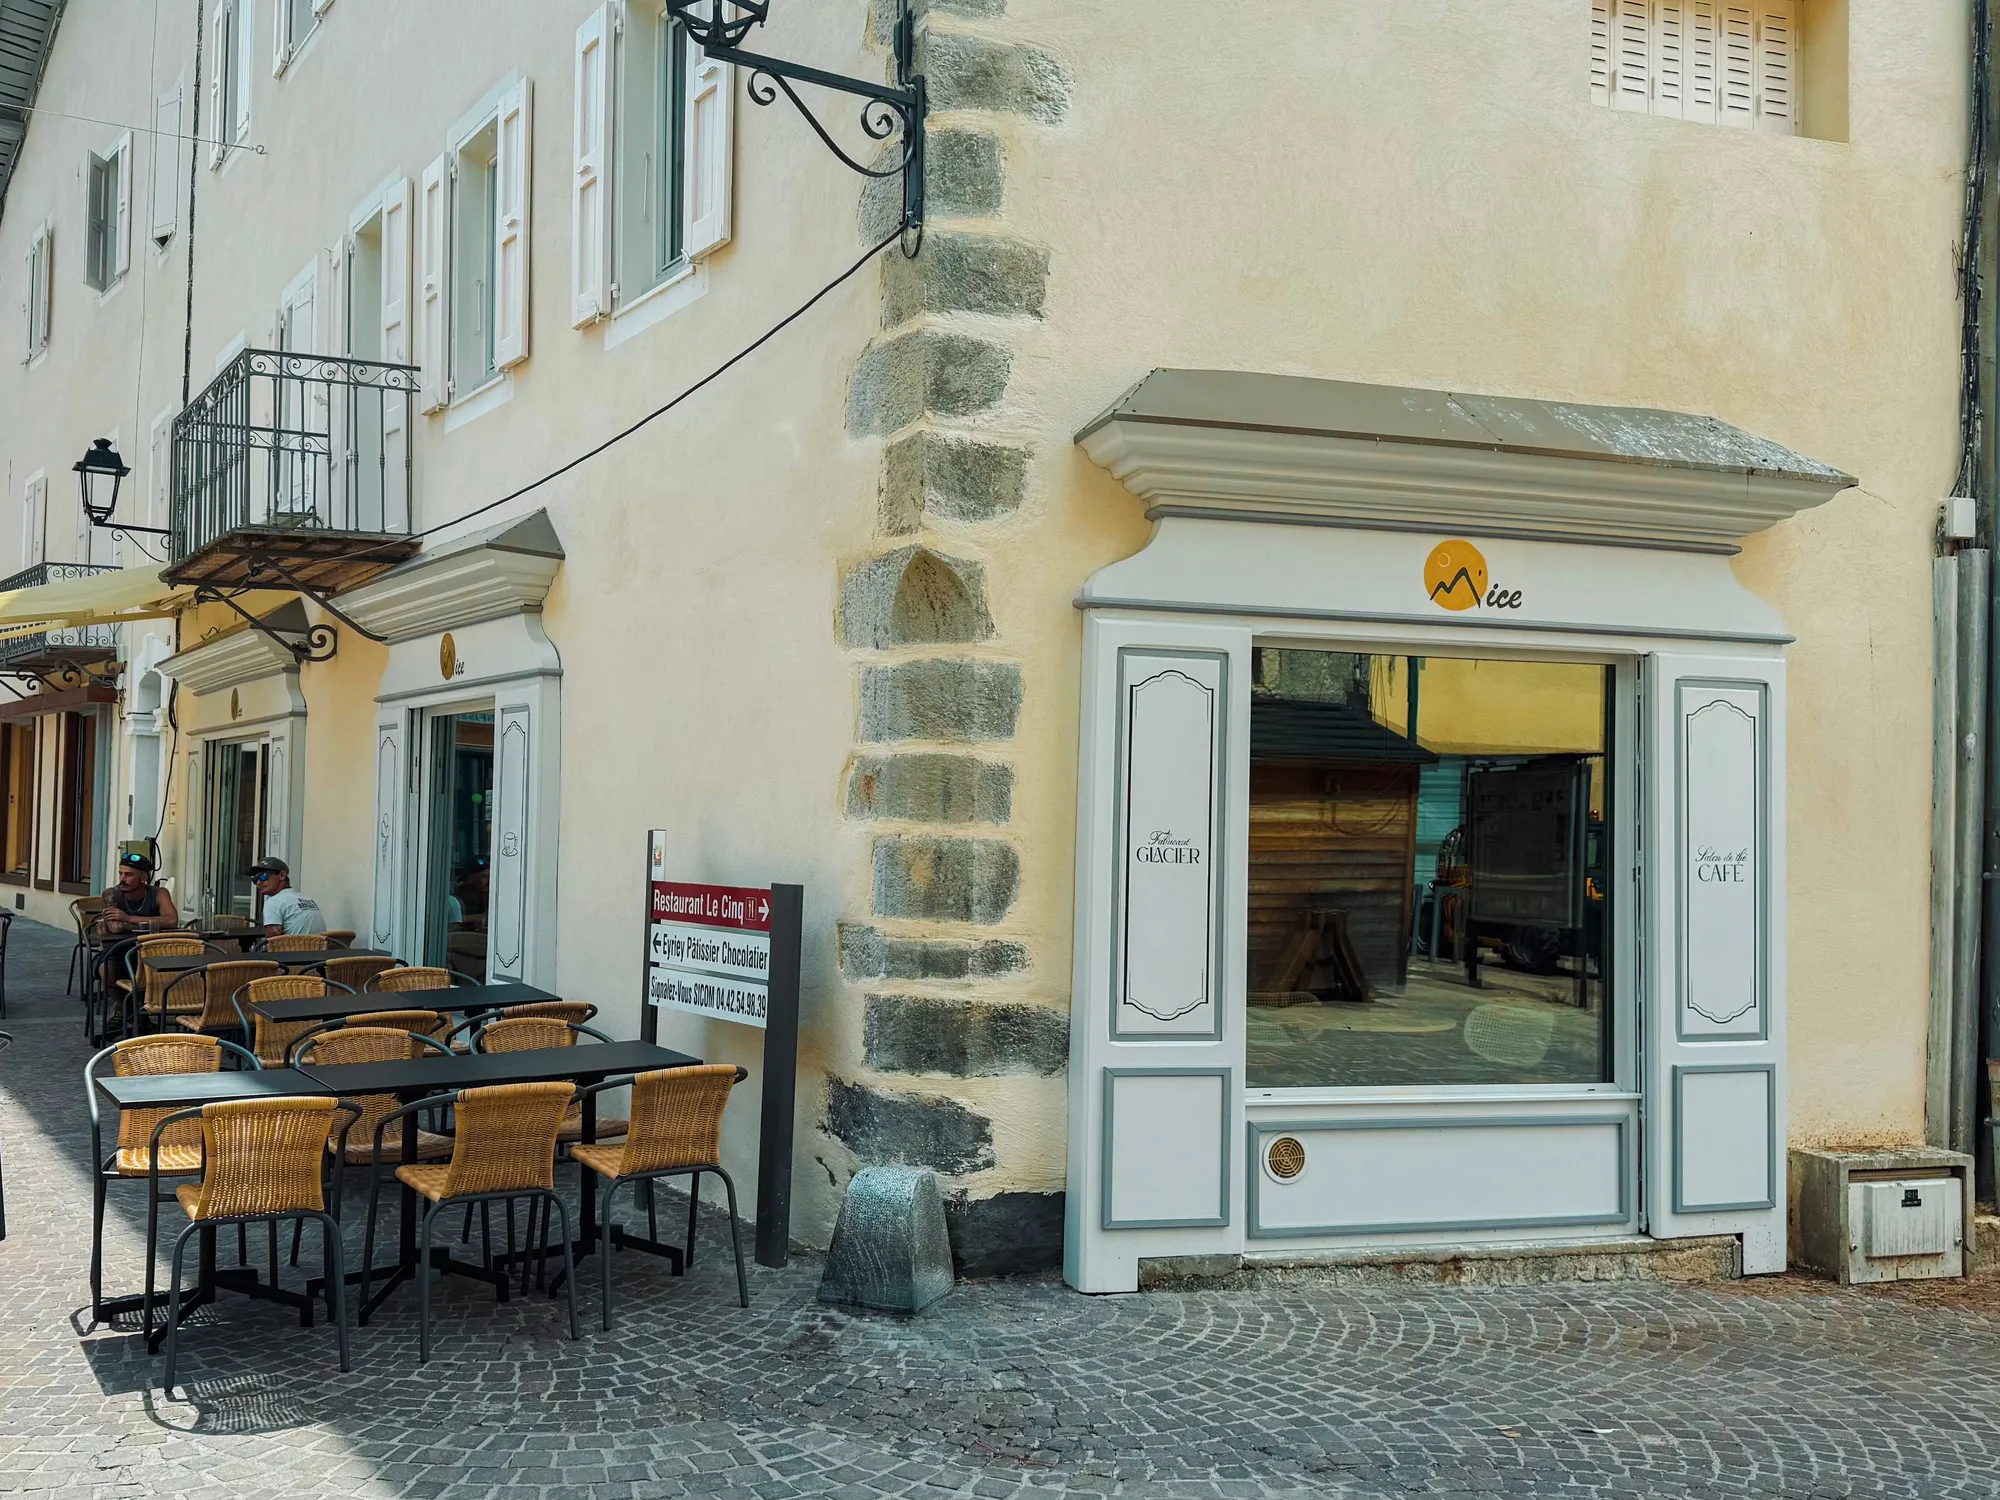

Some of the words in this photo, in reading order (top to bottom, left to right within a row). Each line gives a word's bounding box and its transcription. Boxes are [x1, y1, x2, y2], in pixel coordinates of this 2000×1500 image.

[1136, 846, 1200, 864] GLACIER
[1695, 844, 1721, 862] Salon
[654, 889, 704, 915] Restaurant
[706, 893, 719, 917] Le
[721, 894, 744, 925] Cinq
[663, 933, 685, 962] Eyriey
[686, 936, 720, 963] Pâtissier
[721, 940, 768, 970] Chocolatier
[651, 975, 692, 1004] Signalez-Vous
[693, 983, 715, 1009] SICOM
[716, 987, 766, 1019] 04.42.54.98.39
